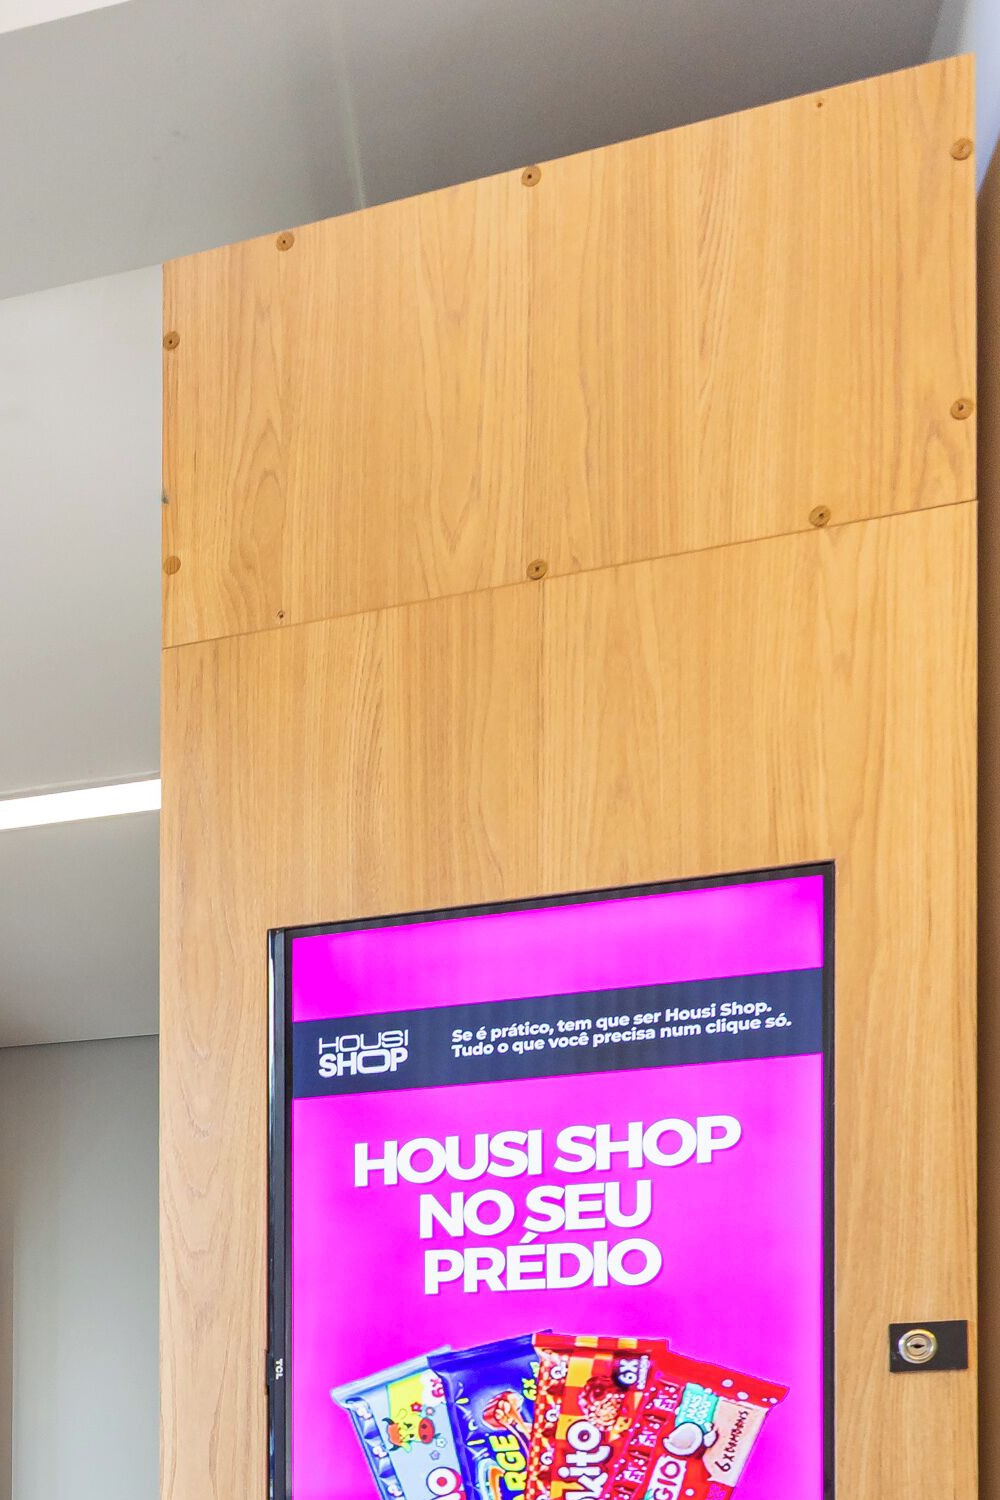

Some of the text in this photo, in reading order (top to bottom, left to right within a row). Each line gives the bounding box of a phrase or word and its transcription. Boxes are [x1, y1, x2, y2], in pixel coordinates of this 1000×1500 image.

[318, 1028, 409, 1055] HOUSI
[451, 1001, 772, 1043] Se é prático, tem que ser Housi Shop.
[451, 1012, 792, 1058] Tudo o que você precisa num clique só.
[318, 1047, 408, 1078] SHOP
[354, 1115, 742, 1187] HOUSI SHOP
[419, 1179, 653, 1240] NO SEU
[424, 1231, 663, 1295] PRÉDIO
[275, 1358, 284, 1380] TCL
